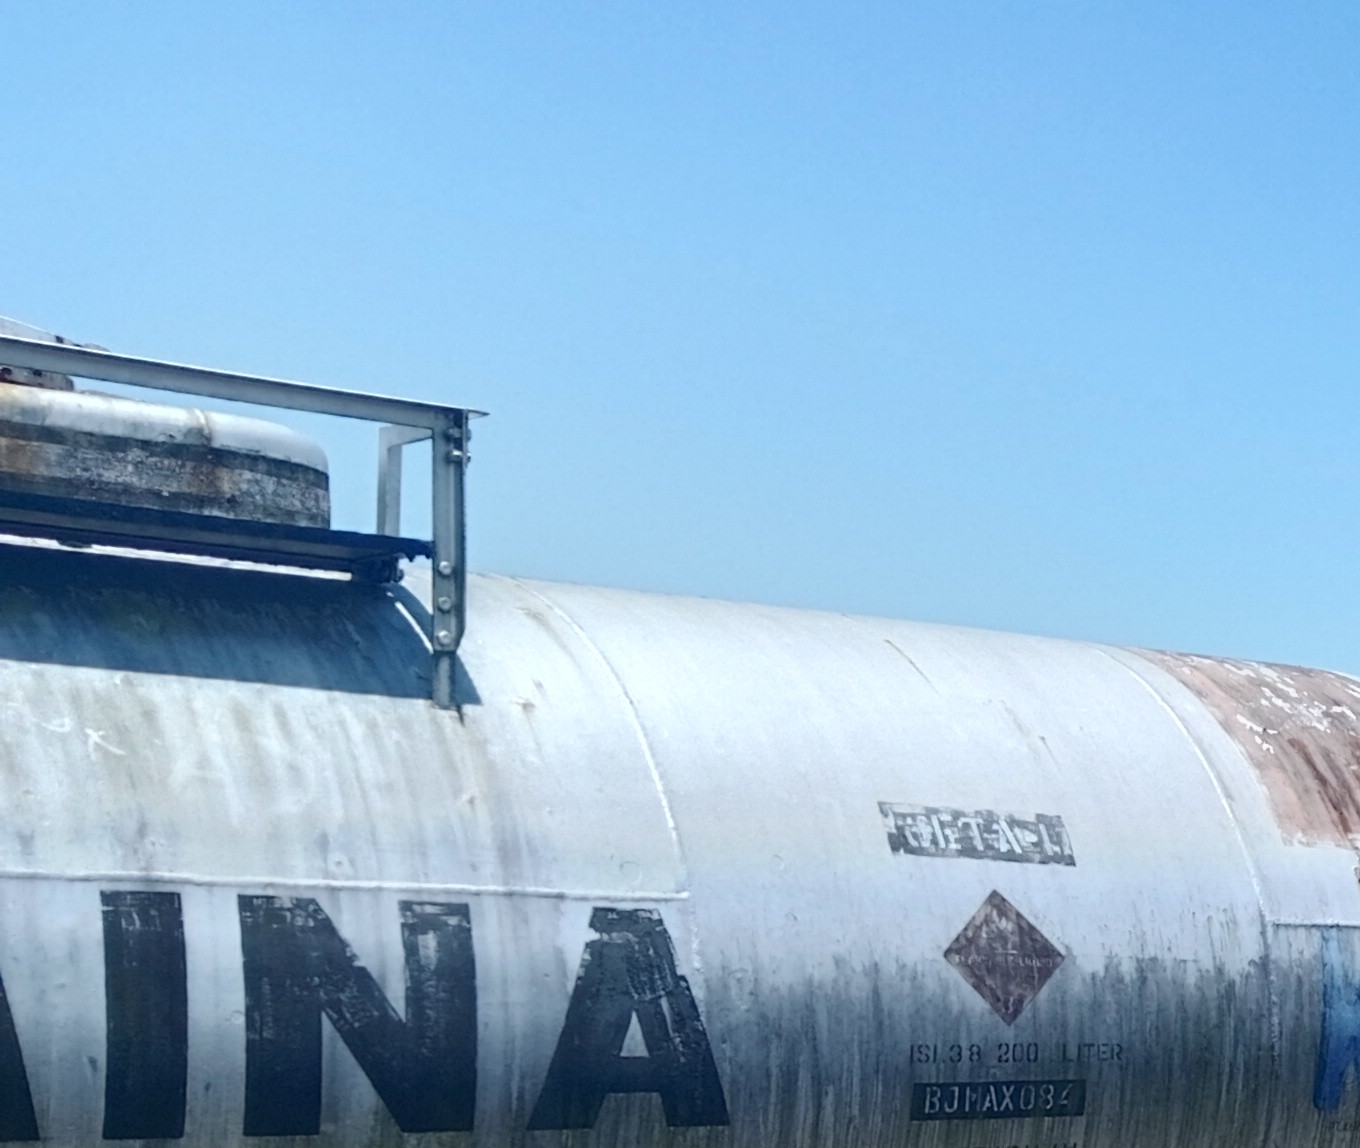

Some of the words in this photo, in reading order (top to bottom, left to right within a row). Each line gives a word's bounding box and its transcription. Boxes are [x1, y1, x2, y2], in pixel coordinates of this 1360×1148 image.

[0, 888, 731, 1142] INA
[998, 1042, 1039, 1064] 200
[1061, 1042, 1124, 1062] LITER
